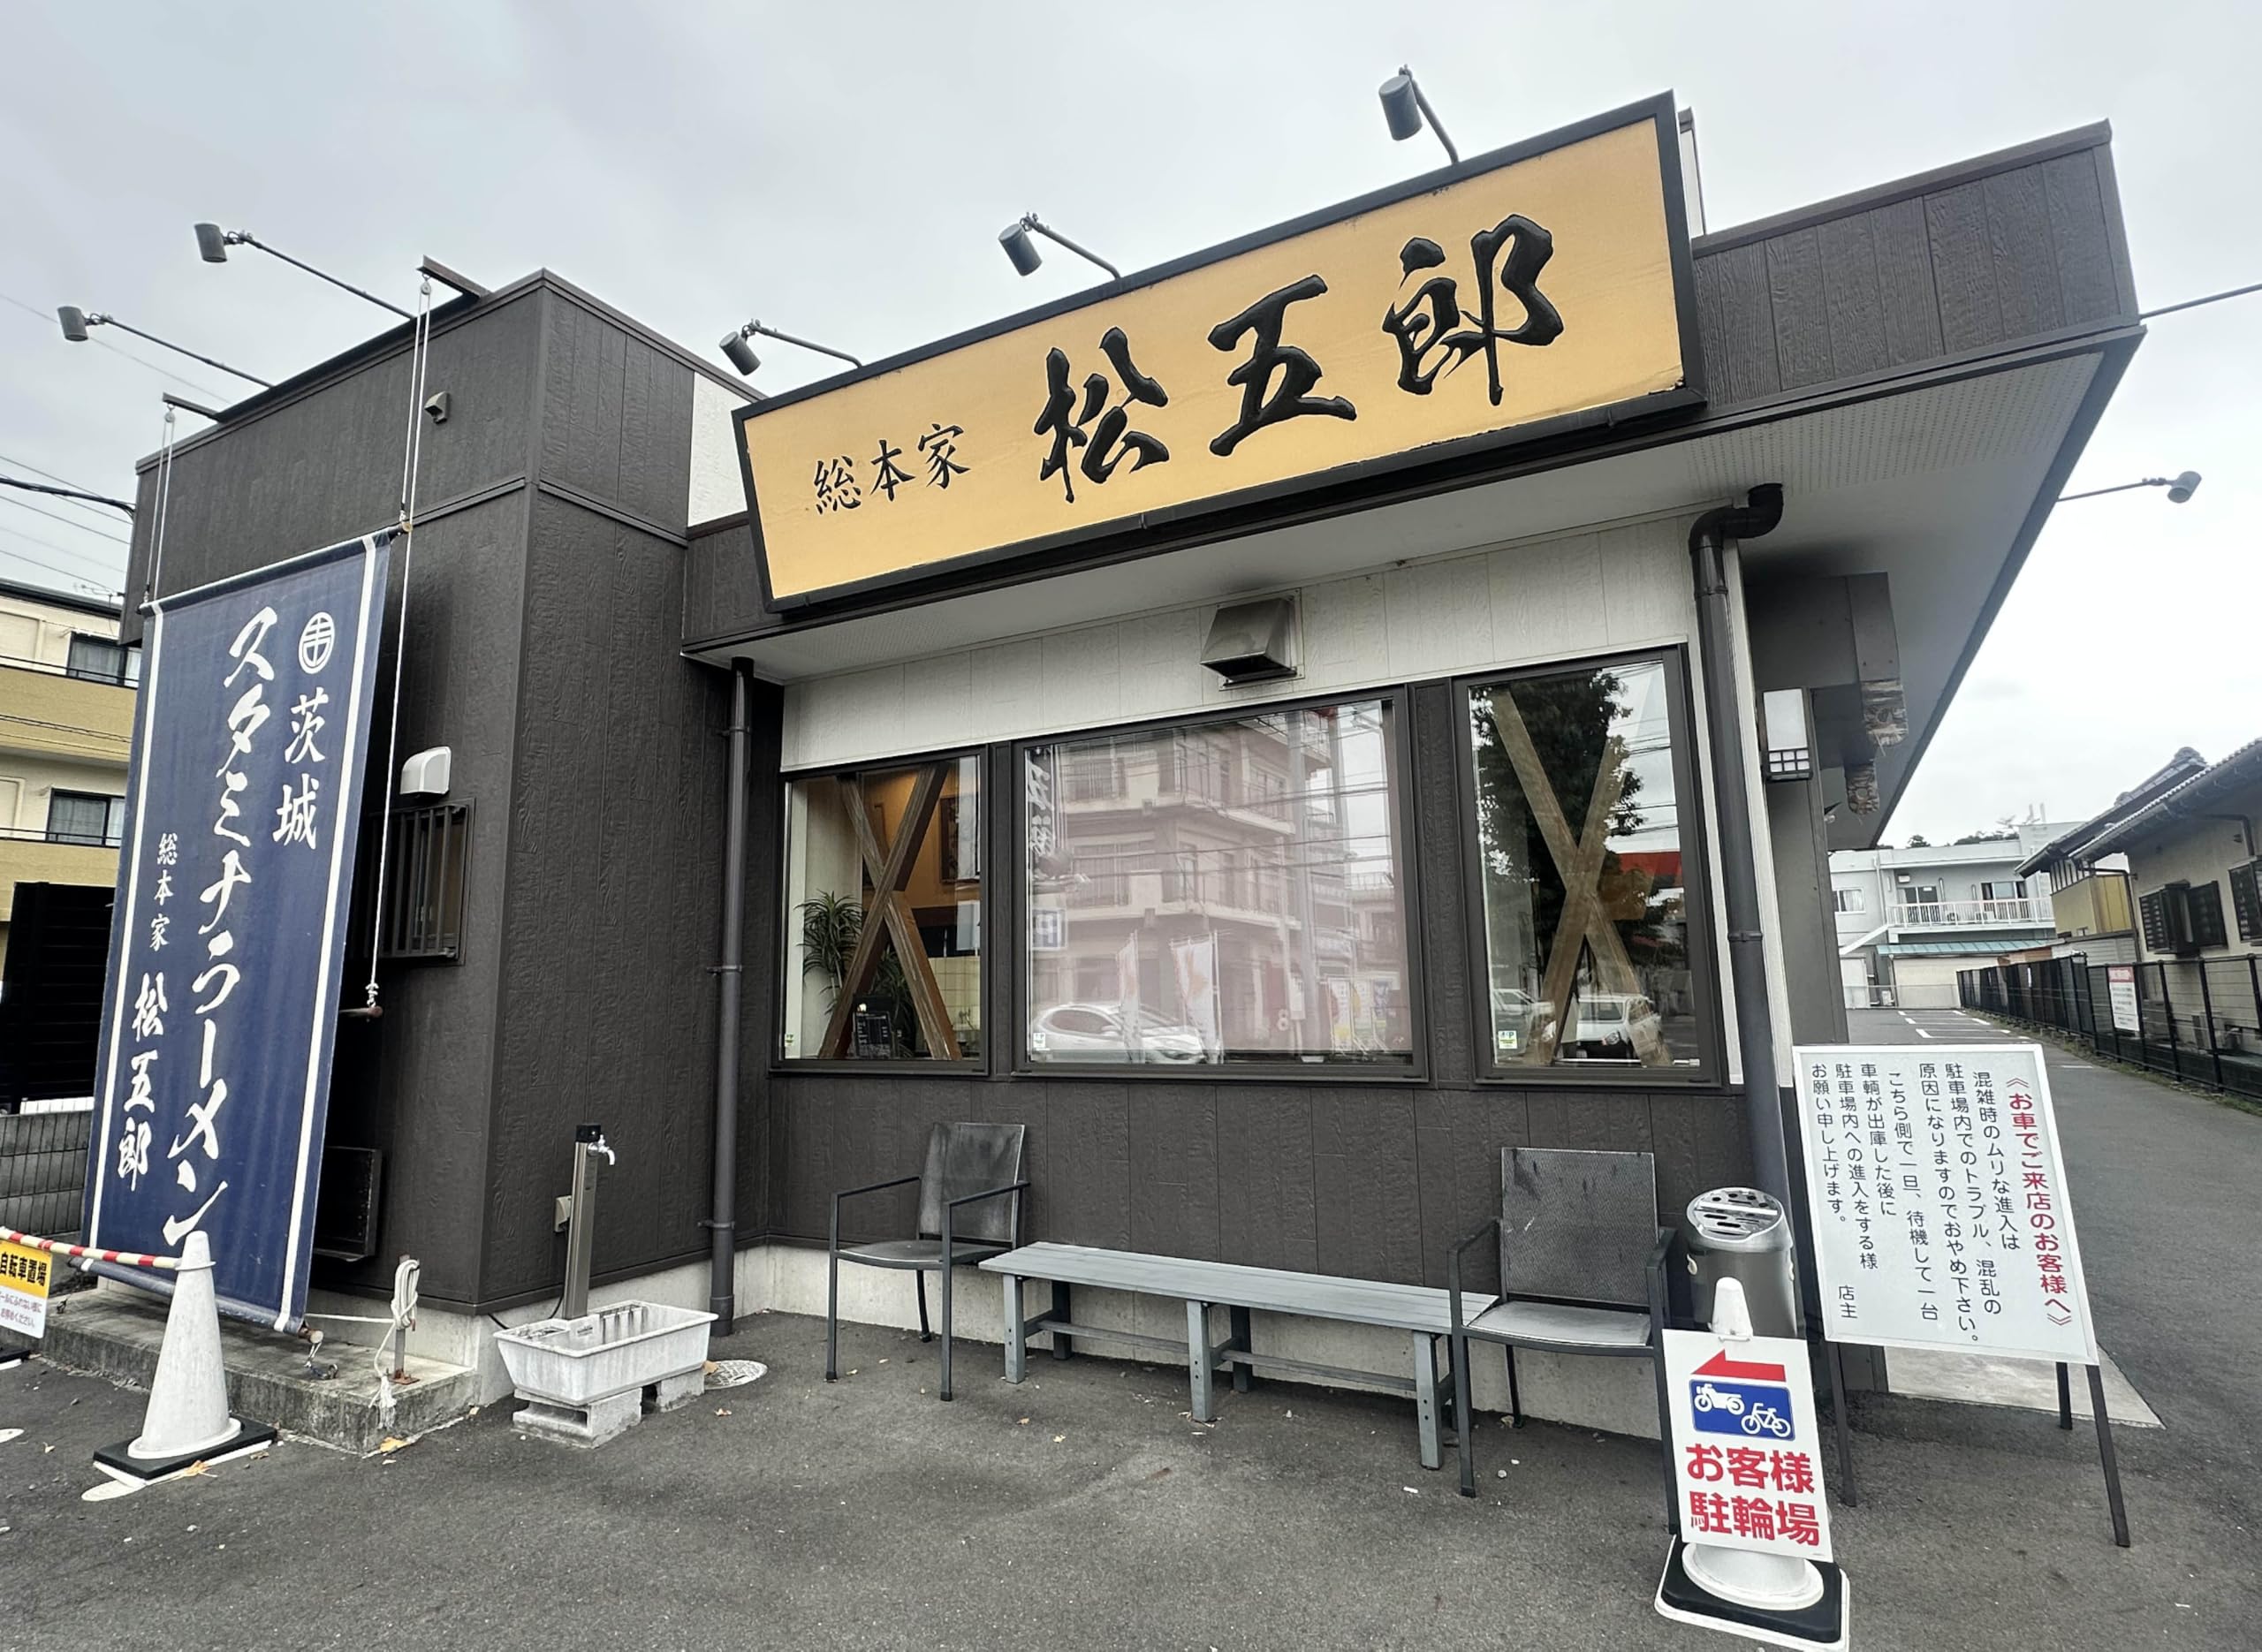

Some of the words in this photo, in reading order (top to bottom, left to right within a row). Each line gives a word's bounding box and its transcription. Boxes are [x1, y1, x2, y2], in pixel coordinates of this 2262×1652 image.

[813, 423, 971, 514] 総本家
[1034, 213, 1563, 504] 松五郎
[272, 686, 330, 850] 茨城
[149, 832, 178, 951] 総本家
[163, 606, 278, 1246] スタミナラーメン
[118, 972, 168, 1192] 松五郎
[1811, 1063, 1846, 1223] お願い申し上げます。
[1973, 1071, 2021, 1250] 混雑時のムリな進入は
[1835, 1063, 1879, 1269] 駐車場内への進入をする様
[1919, 1063, 1978, 1341] 原因になりますのでおやめ下さい。
[0, 1251, 48, 1287] 自転車置場
[1838, 1284, 1858, 1319] 店主
[1686, 1443, 1815, 1494] お客様
[1689, 1489, 1820, 1547] 駐輪場
